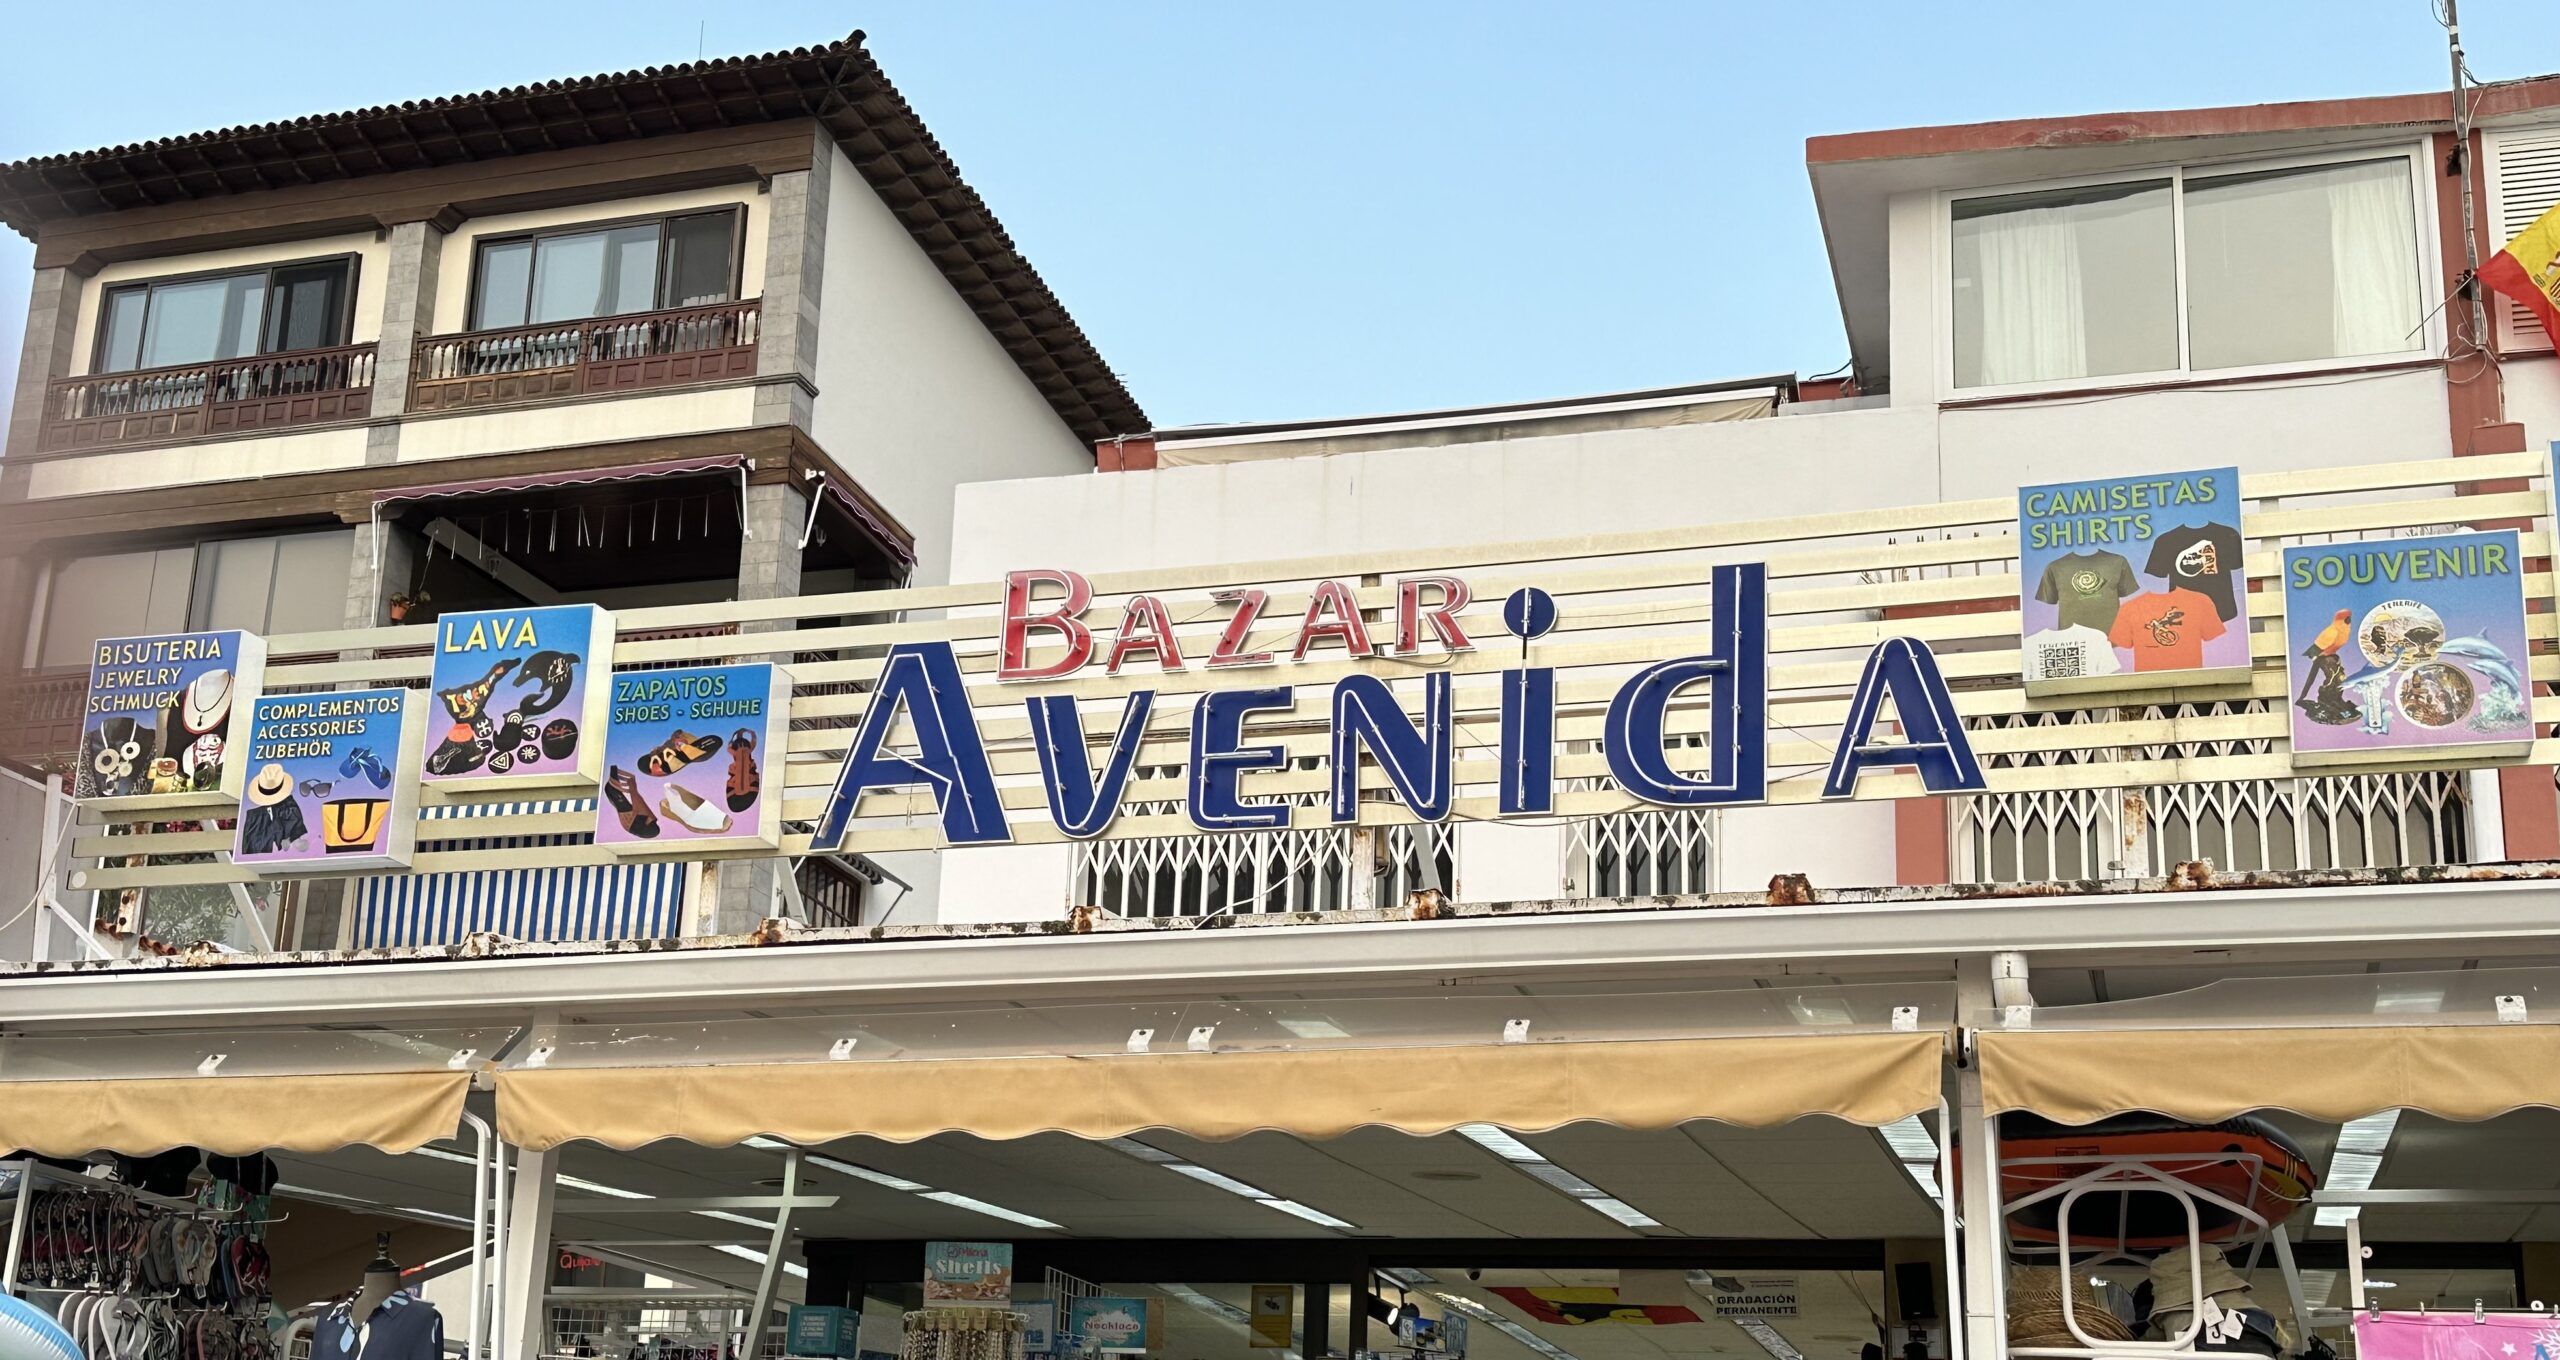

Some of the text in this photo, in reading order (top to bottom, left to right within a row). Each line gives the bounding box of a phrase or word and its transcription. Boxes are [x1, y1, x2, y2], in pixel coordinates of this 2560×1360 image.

[2026, 476, 2216, 518] CAMISETAS
[2031, 514, 2153, 549] SHIRTS
[2292, 543, 2510, 589] SOUVENIR
[444, 616, 539, 653] LAVA
[996, 568, 1478, 682] BAZAR
[98, 637, 222, 667] BISUTERIA
[94, 666, 183, 690] JEWELRY
[616, 675, 727, 703] ZAPATOS
[90, 690, 181, 714] SCHMUCK
[258, 697, 400, 721] COMPLEMENTOS
[614, 704, 669, 724] SHOES
[691, 699, 761, 719] SCHUHE
[257, 719, 366, 740] ACCESSORIES
[254, 739, 332, 761] ZUBEHÖR
[935, 1258, 1002, 1275] Shells
[1716, 1306, 1797, 1315] PERMANENTE
